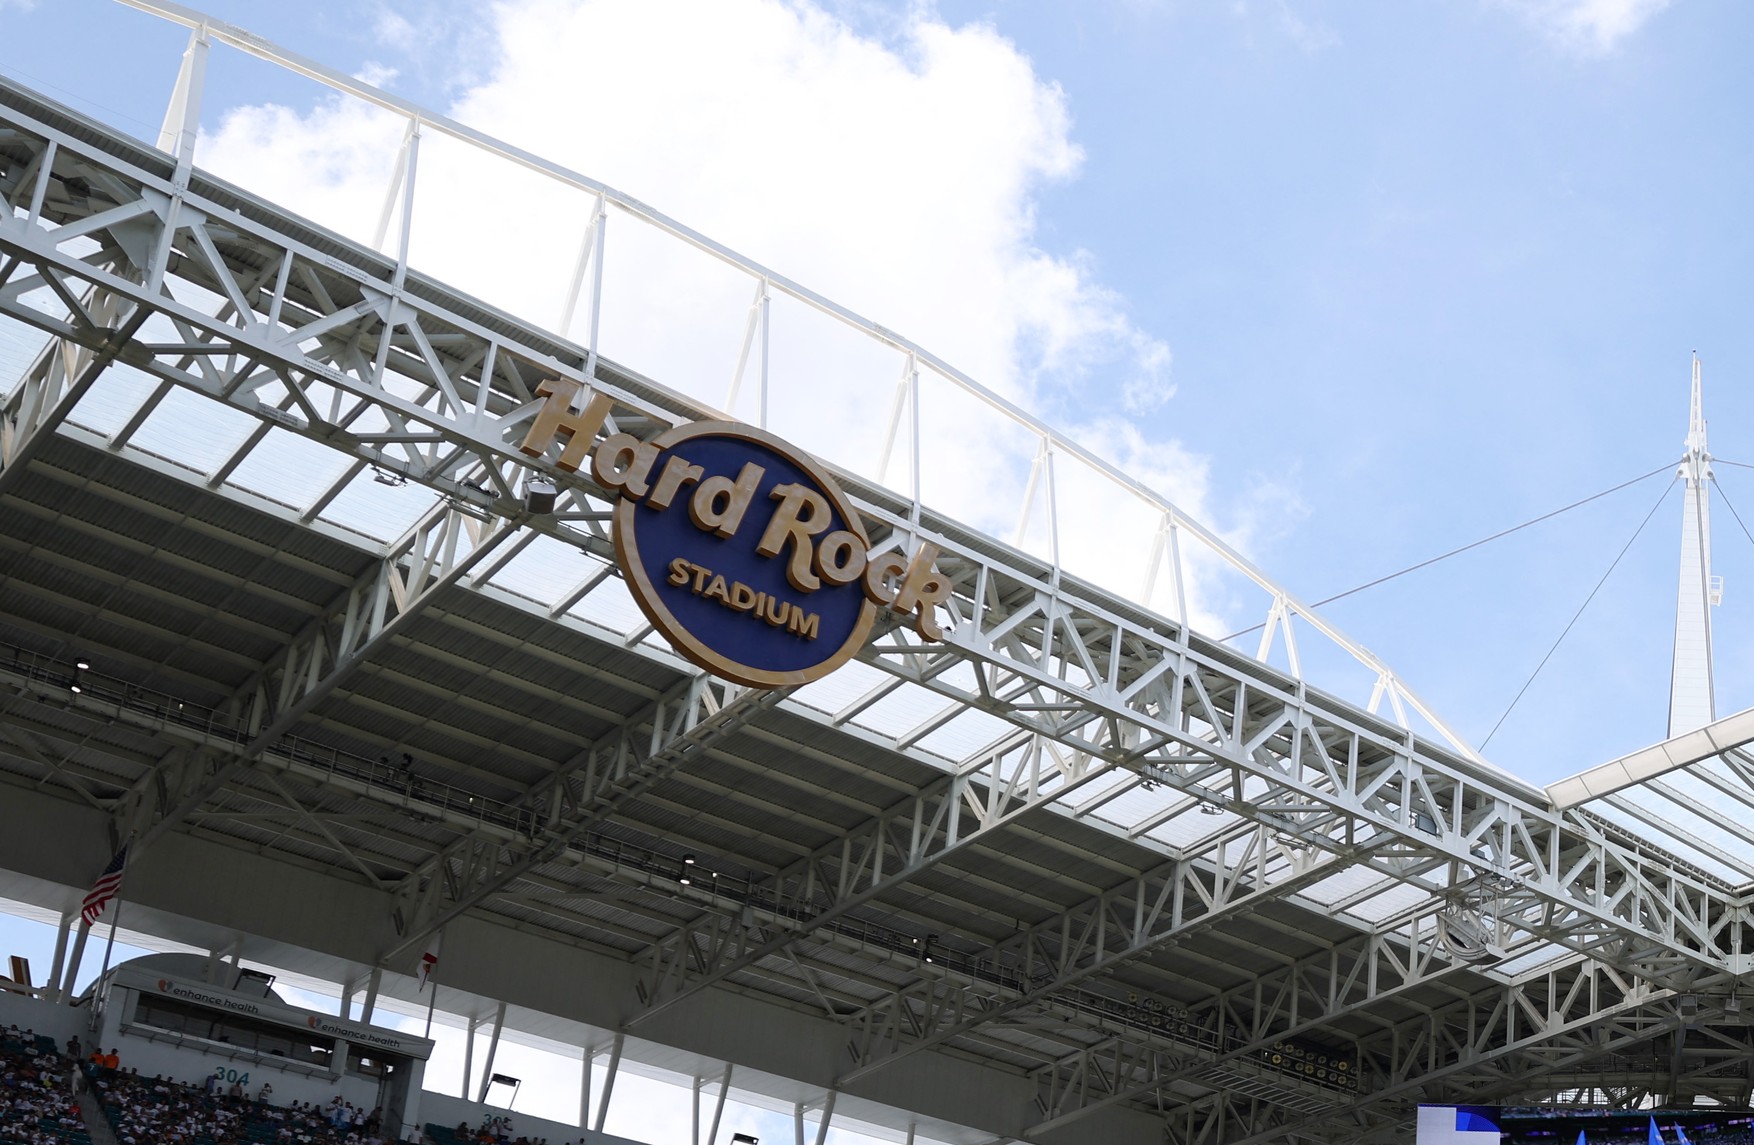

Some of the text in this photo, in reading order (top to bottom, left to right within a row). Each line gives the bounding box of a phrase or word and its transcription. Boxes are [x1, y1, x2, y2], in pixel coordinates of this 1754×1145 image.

[519, 376, 953, 643] Hard Rock
[667, 557, 820, 640] STADIUM
[173, 987, 259, 1015] enhance health
[321, 1023, 401, 1048] enhance health
[215, 1066, 249, 1087] 304
